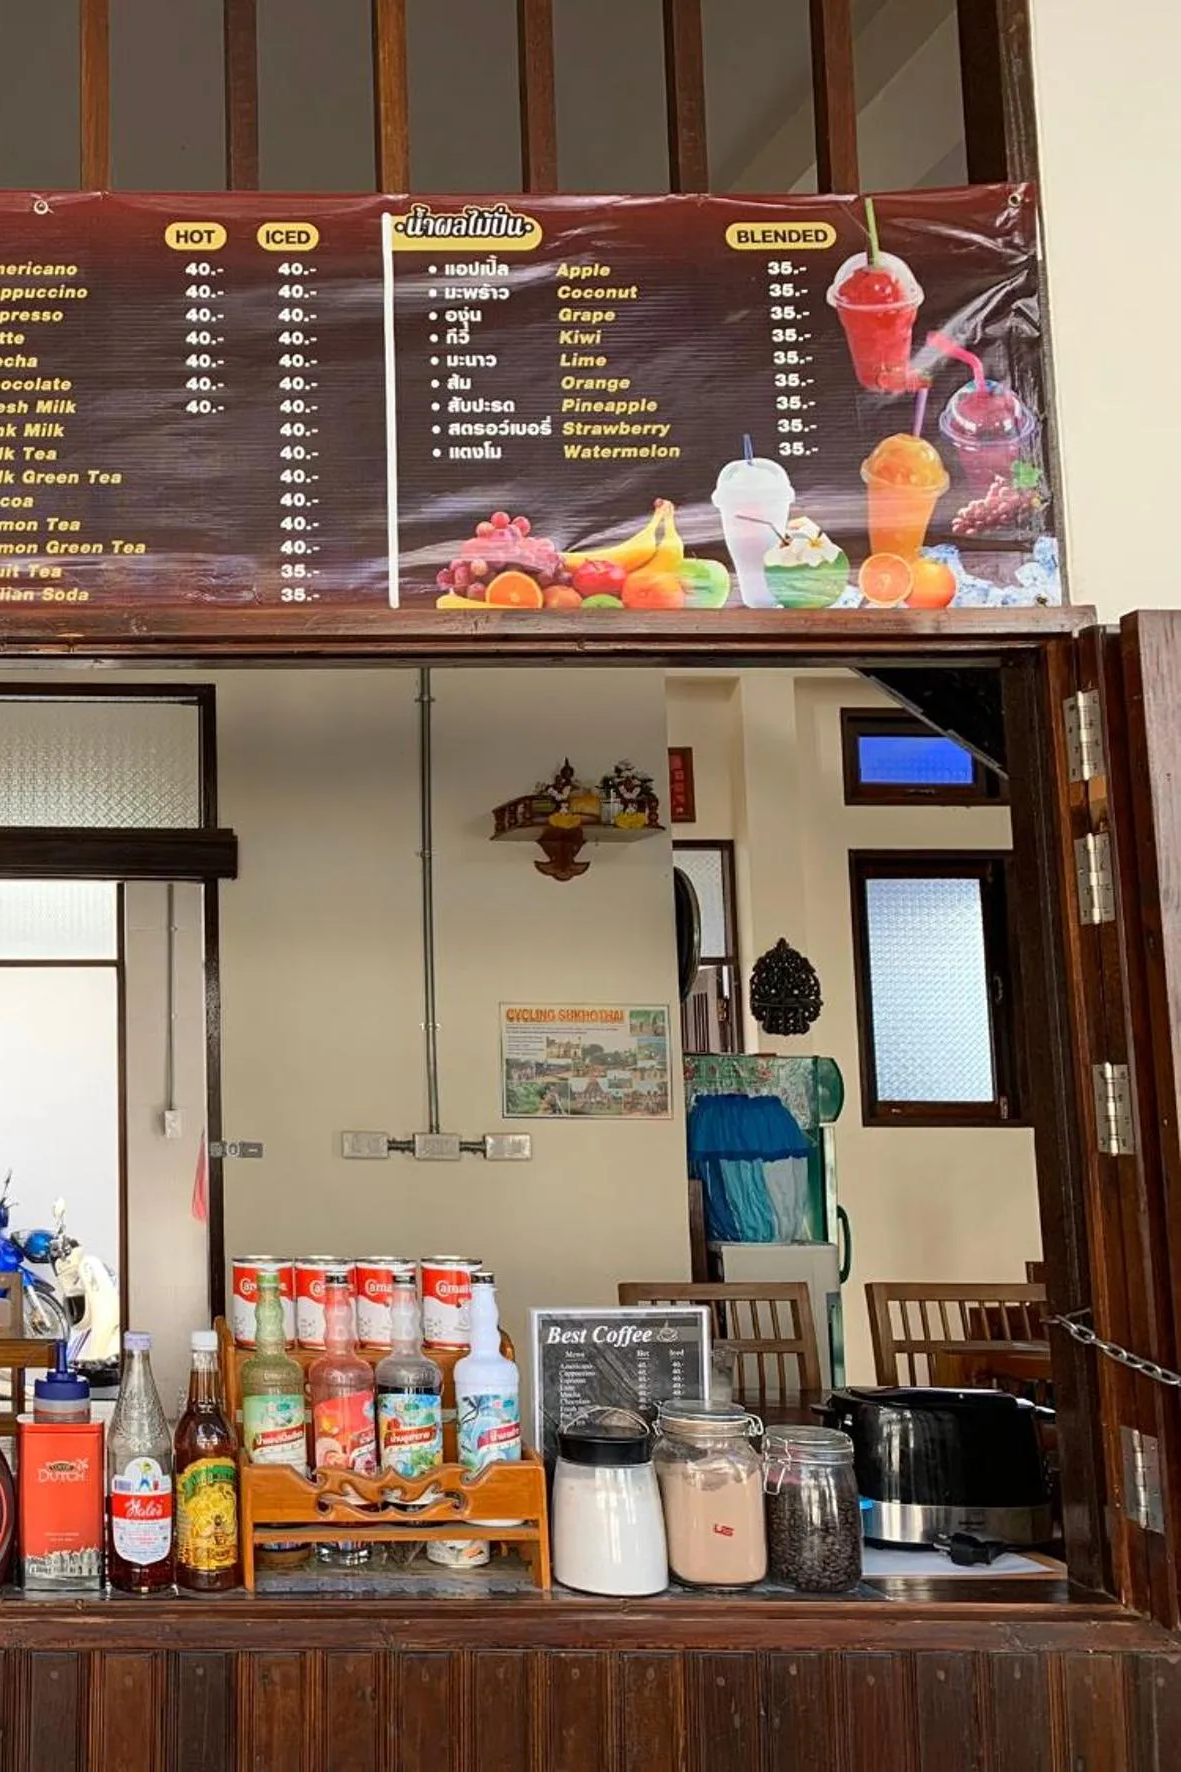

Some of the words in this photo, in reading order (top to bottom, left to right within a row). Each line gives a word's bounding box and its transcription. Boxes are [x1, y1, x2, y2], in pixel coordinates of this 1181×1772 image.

[405, 205, 525, 237] น้ำผลไม้ปั่น
[175, 229, 216, 244] HOT
[265, 229, 311, 245] ICED
[736, 229, 828, 243] BLENDED
[185, 262, 224, 276] 40.-
[278, 262, 316, 276] 40.-
[444, 254, 510, 276] แอปเปิ้ล
[557, 263, 611, 280] Apple
[768, 261, 807, 275] 35.-
[185, 284, 224, 299] 40.-
[278, 284, 317, 299] 40.-
[444, 283, 510, 300] มะพร้าว
[557, 285, 638, 299] Coconut
[769, 283, 808, 297] 35.-
[185, 308, 224, 322] 40.-
[278, 308, 317, 322] 40.-
[444, 306, 482, 326] องุ่น
[558, 307, 616, 324] Grape
[770, 306, 810, 320] 35.-
[186, 331, 224, 345] 40.-
[278, 331, 317, 345] 40.-
[446, 324, 470, 344] กีวี่
[559, 330, 601, 345] Kiwi
[772, 328, 811, 342] 35.-
[186, 354, 224, 368] 40.-
[279, 354, 318, 368] 40.-
[446, 354, 497, 367] มะนาว
[560, 355, 607, 367] Lime
[773, 350, 813, 365] 35.-
[186, 377, 224, 391] 40.-
[279, 376, 318, 391] 40.-
[447, 373, 472, 390] ส้ม
[561, 375, 631, 393] Orange
[775, 373, 814, 387] 35.-
[35, 399, 76, 414] Milk
[186, 399, 224, 414] 40.-
[279, 399, 318, 414] 40.-
[447, 396, 516, 413] สับปะรด
[561, 398, 658, 415] Pineapple
[776, 396, 816, 410] 35.-
[23, 422, 64, 438] Milk
[279, 422, 319, 437] 40.-
[448, 415, 552, 436] สตรอว์เบอรี่
[562, 421, 671, 437] Strawberry
[777, 418, 817, 433] 35.-
[23, 446, 57, 461] Tea
[279, 445, 319, 460] 40.-
[449, 440, 502, 459] แตงโม
[563, 444, 681, 459] Watermelon
[779, 442, 819, 456] 35.-
[22, 470, 80, 484] Green
[87, 470, 122, 484] Tea
[280, 469, 319, 483] 40.-
[280, 492, 319, 507] 40.-
[47, 517, 81, 532] Tea
[280, 516, 319, 531] 40.-
[45, 540, 104, 554] Green
[111, 540, 146, 554] Tea
[280, 540, 320, 555] 40.-
[29, 563, 63, 578] Tea
[281, 564, 320, 579] 35.-
[39, 587, 90, 602] Soda
[281, 587, 320, 602] 35.-
[506, 1008, 555, 1022] CYCLING
[547, 1326, 587, 1344] Best
[592, 1325, 653, 1347] Coffee
[38, 1469, 85, 1482] DUTCH
